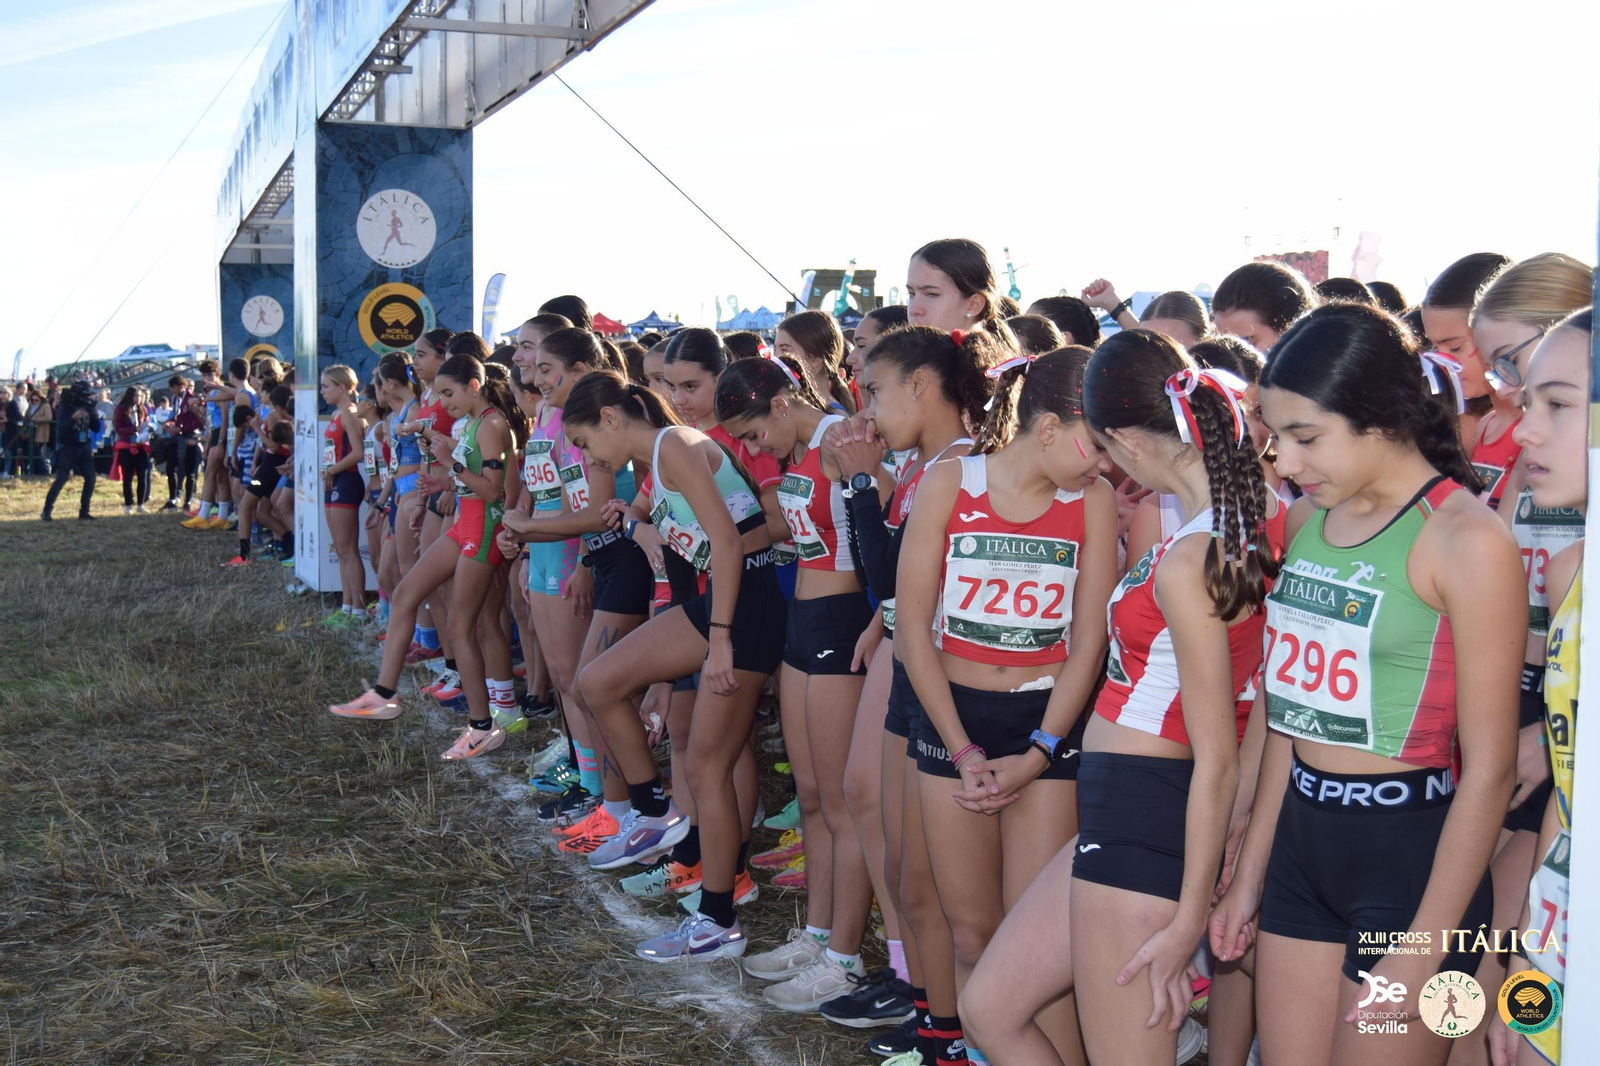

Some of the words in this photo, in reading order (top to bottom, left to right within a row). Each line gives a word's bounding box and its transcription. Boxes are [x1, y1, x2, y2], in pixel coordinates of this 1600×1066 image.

[363, 193, 429, 225] ITÁLICA
[363, 296, 374, 314] GOLD
[373, 288, 391, 300] LEVEL
[568, 489, 590, 511] 45
[781, 507, 812, 537] 61
[746, 549, 774, 570] NIKE
[986, 537, 1048, 556] ITÁLICA
[957, 575, 1065, 620] 7262
[1283, 577, 1336, 607] ITÁLICA
[1264, 625, 1358, 702] 7296
[1291, 762, 1316, 797] KE
[1318, 779, 1409, 806] PRO
[644, 871, 694, 895] HYROX
